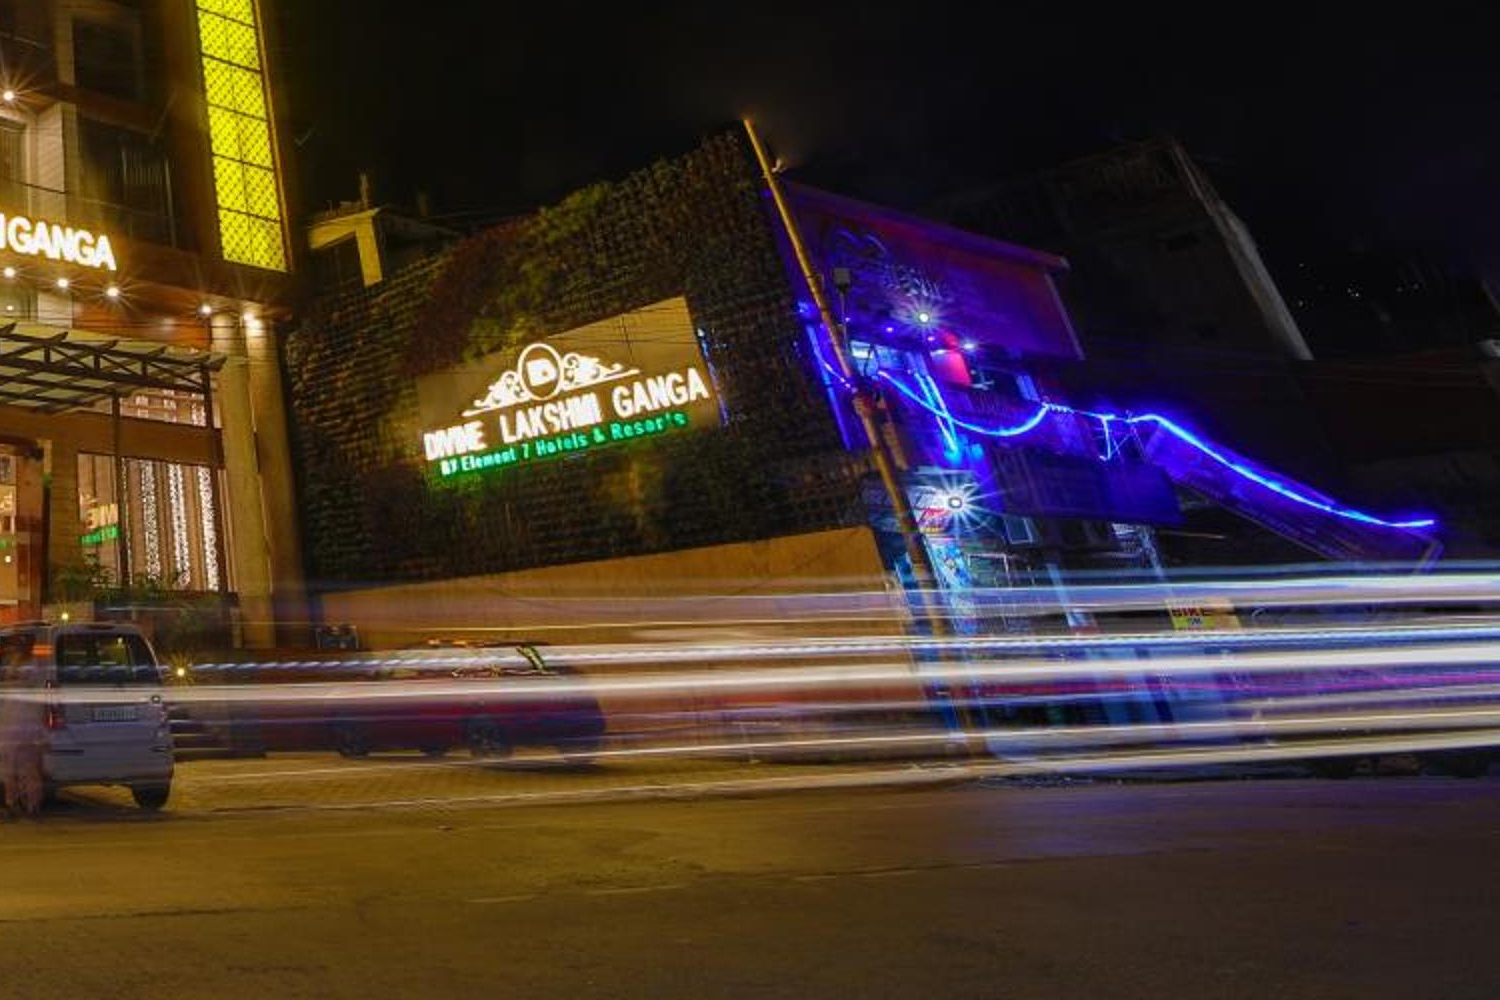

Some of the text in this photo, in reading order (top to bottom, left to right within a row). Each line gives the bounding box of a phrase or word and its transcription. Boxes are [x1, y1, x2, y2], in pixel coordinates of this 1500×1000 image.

[7, 216, 118, 271] GANGA
[500, 392, 603, 444] LAKSHMI
[611, 367, 710, 419] GANGA
[460, 446, 517, 471] Element
[521, 442, 530, 459] 7
[535, 432, 589, 456] Hotels
[593, 426, 606, 444] &
